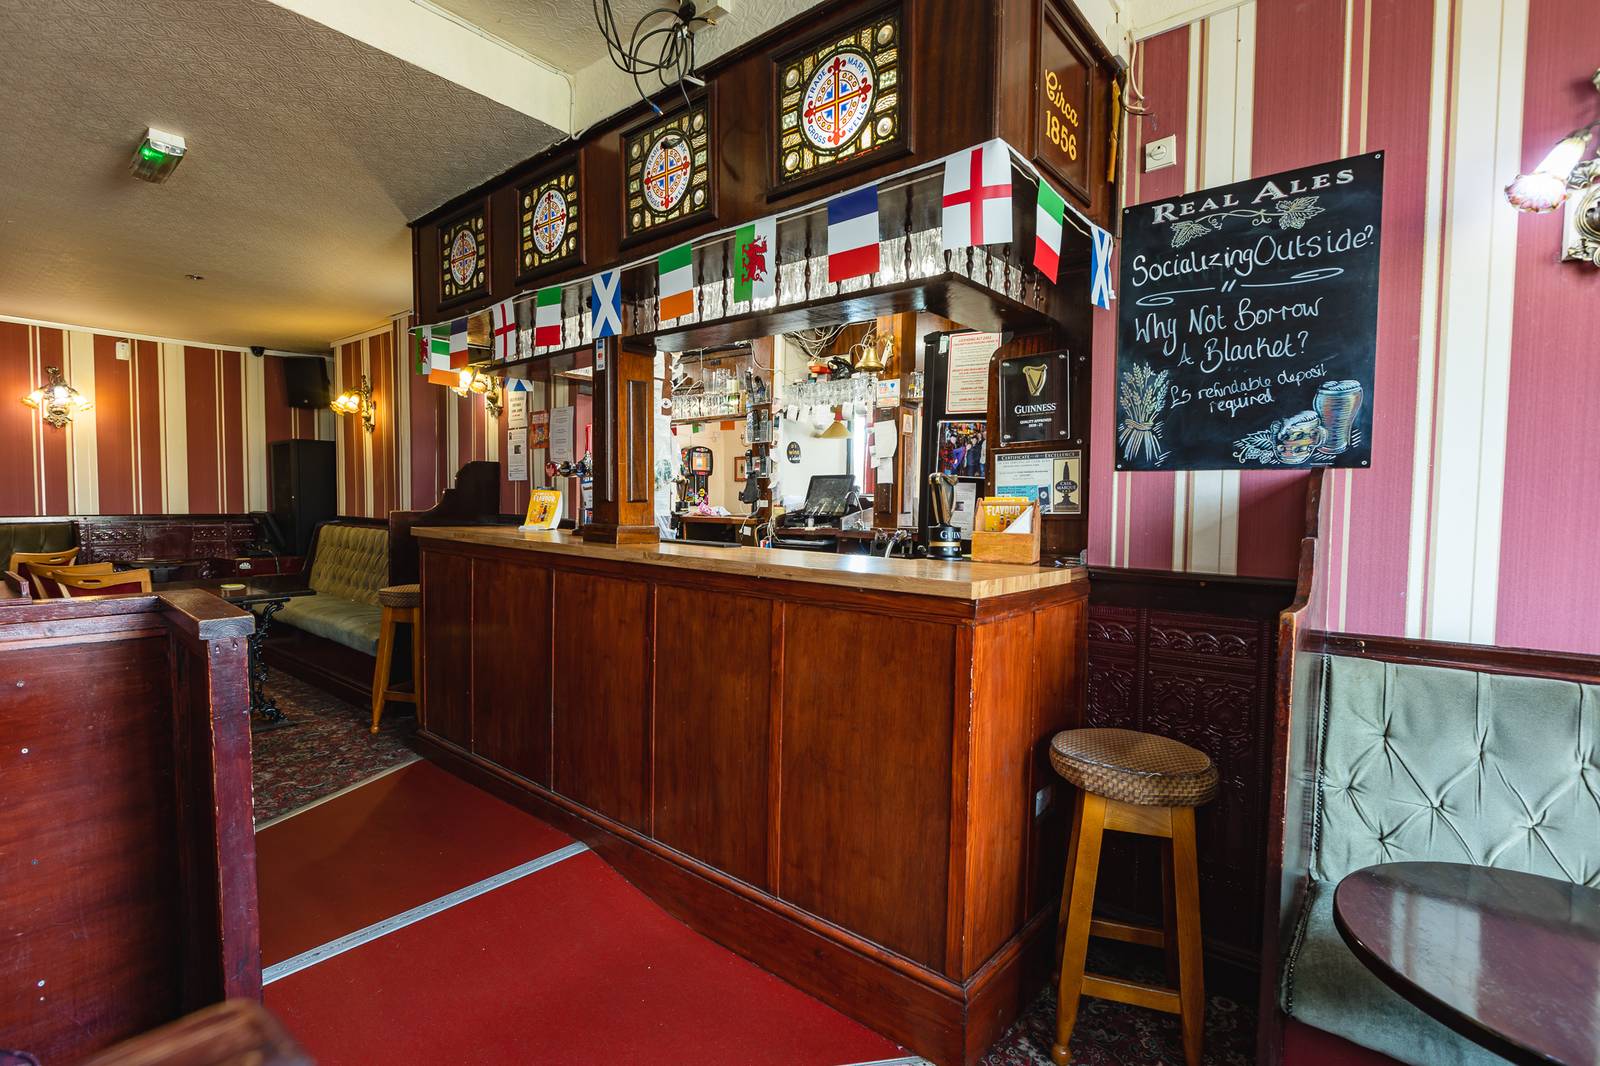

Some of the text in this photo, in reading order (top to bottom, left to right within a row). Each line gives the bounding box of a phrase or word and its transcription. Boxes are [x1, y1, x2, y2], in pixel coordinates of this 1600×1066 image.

[808, 57, 868, 99] TRADE MARK
[1045, 68, 1078, 127] Circa
[807, 103, 867, 144] CROSS WELLS
[1046, 110, 1076, 160] 1856
[647, 145, 660, 170] TRADE
[1152, 169, 1354, 224] REAL ALES
[1135, 297, 1324, 356] Why Not Borrow
[1177, 331, 1309, 373] A Blanket?
[1170, 385, 1192, 409] £5
[1277, 363, 1328, 385] deposit
[1209, 389, 1275, 418] required
[1014, 402, 1057, 414] GUINNESS
[986, 505, 1022, 516] FLAVOUR
